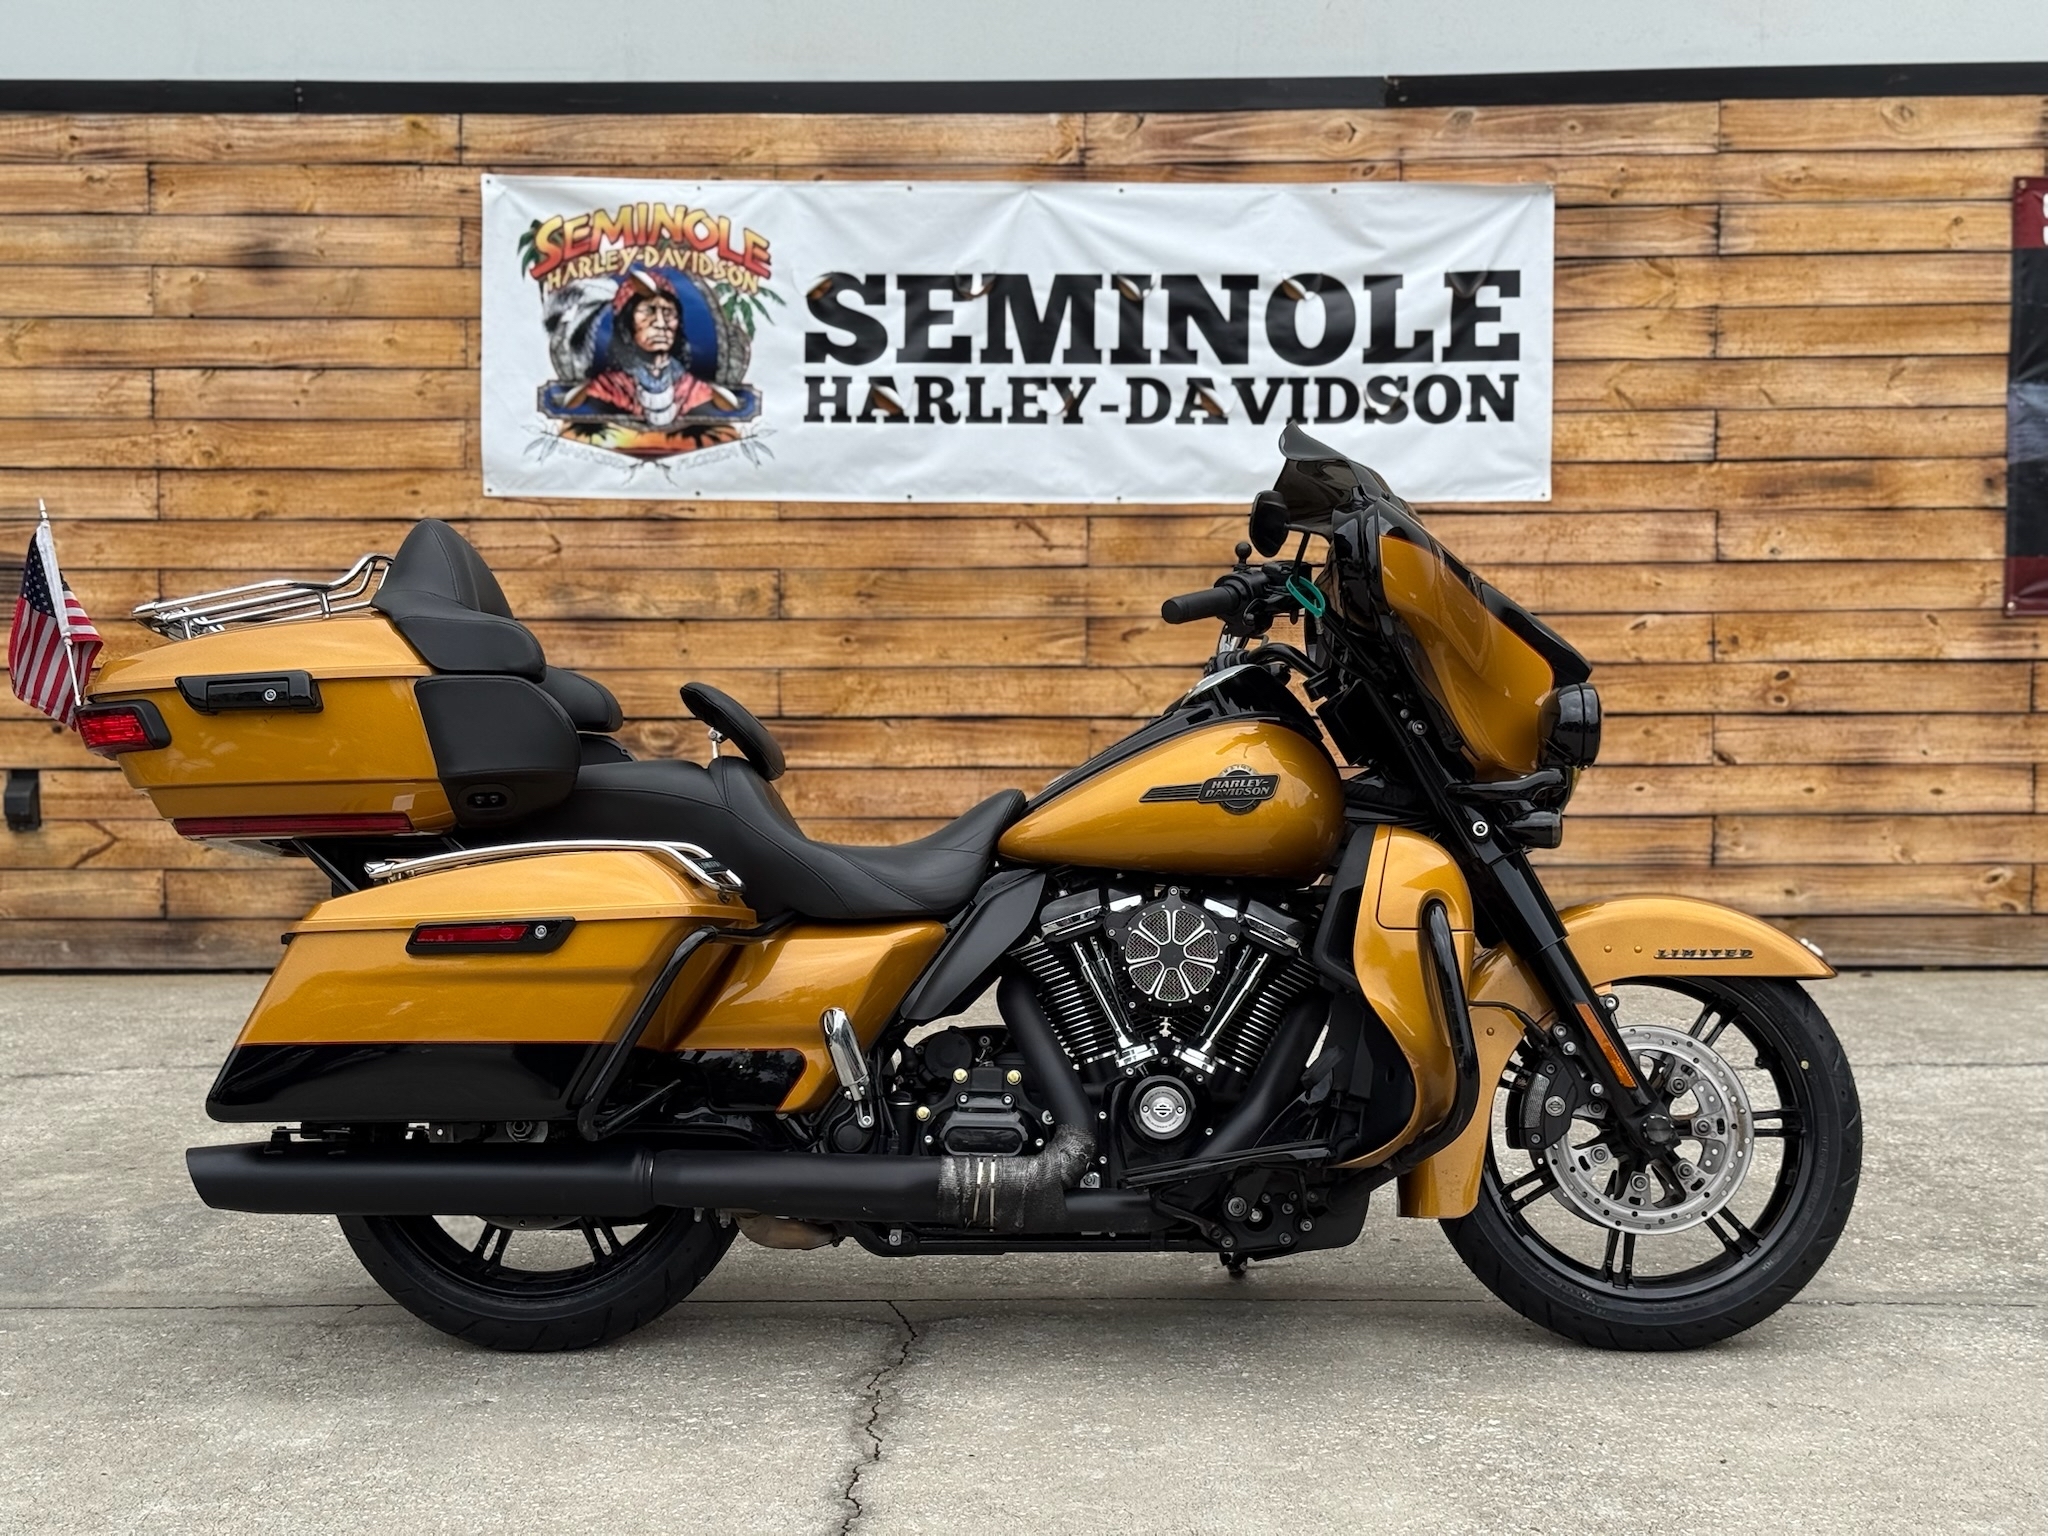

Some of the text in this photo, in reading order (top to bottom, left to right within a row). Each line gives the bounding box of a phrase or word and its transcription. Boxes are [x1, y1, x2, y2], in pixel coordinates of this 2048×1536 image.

[529, 201, 772, 279] SEMINOLE
[547, 246, 760, 294] HARLEY-DAVIDSON
[804, 269, 1521, 367] SEMINOLE
[803, 373, 1520, 425] HARLEY-DAVIDSON
[1205, 787, 1270, 797] DAVIDSON
[1211, 779, 1269, 789] HARLEY-
[1656, 949, 1753, 959] LIMITED
